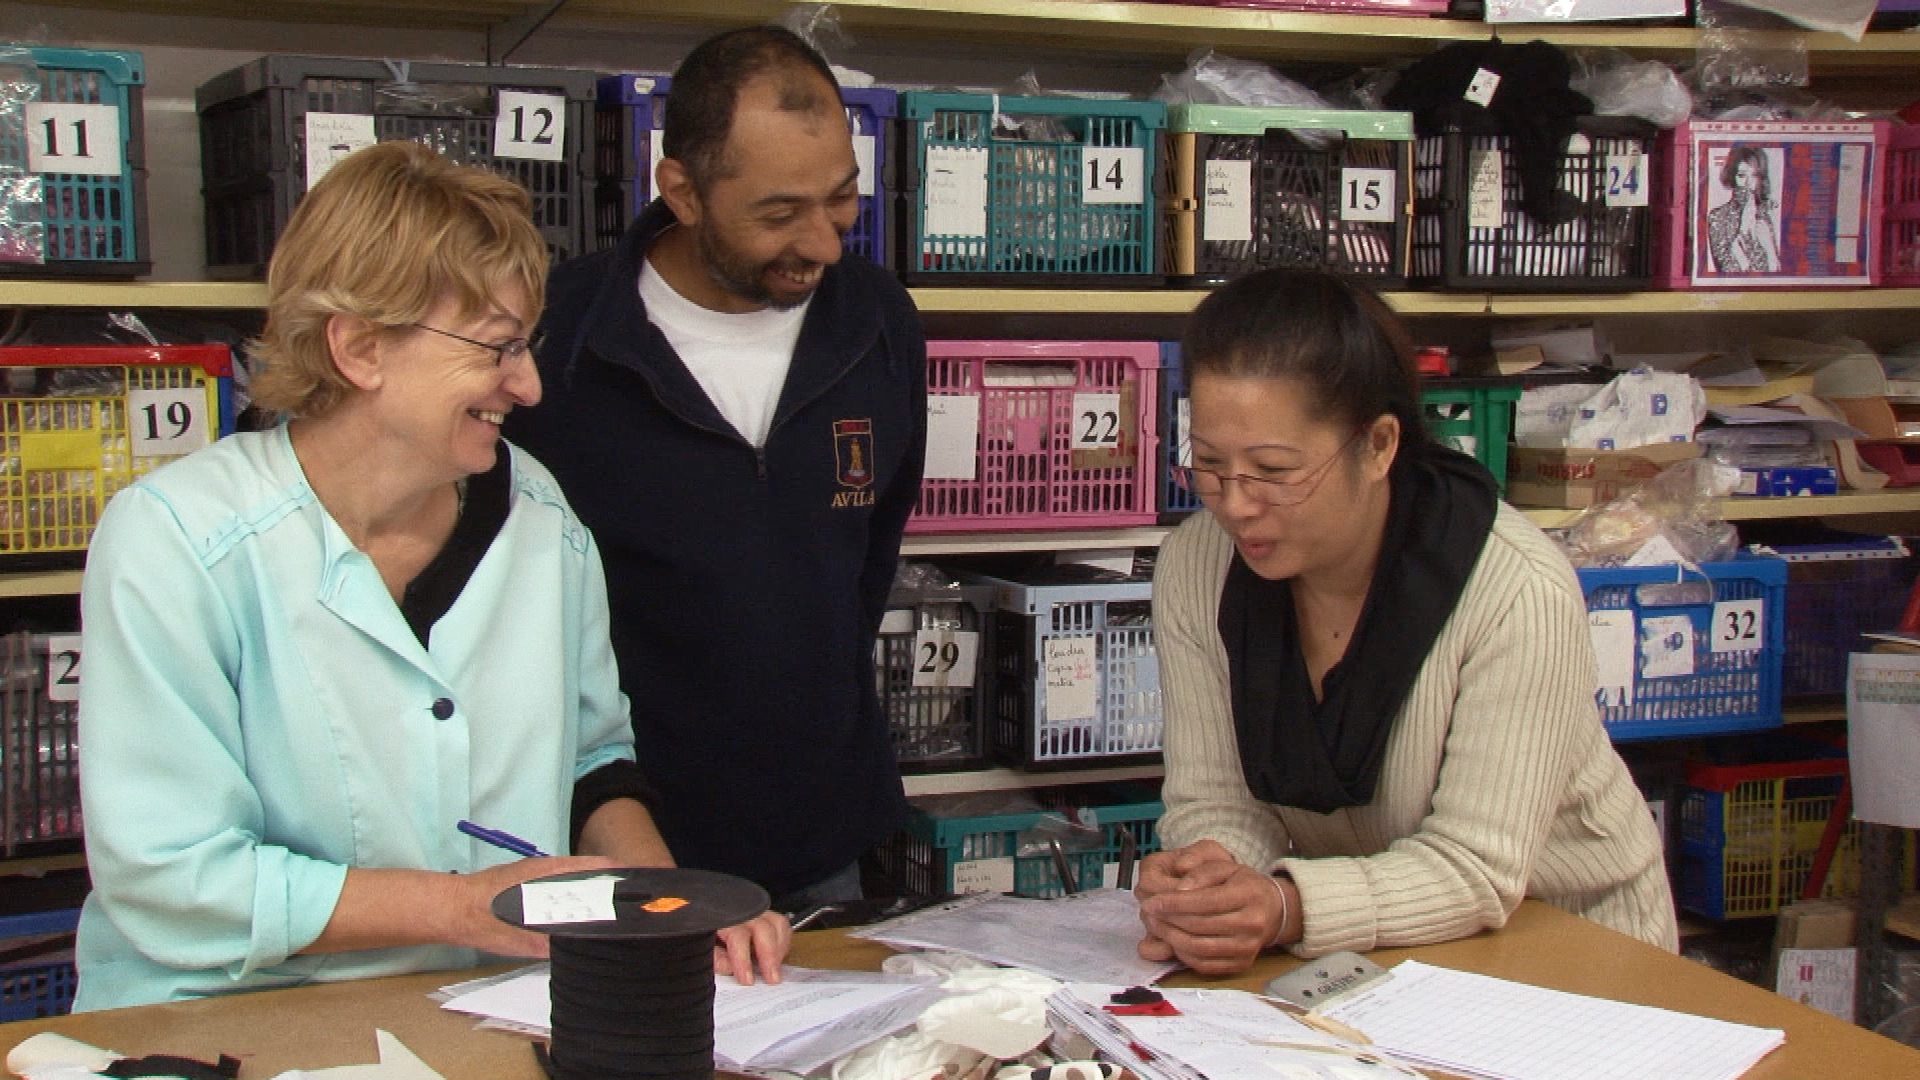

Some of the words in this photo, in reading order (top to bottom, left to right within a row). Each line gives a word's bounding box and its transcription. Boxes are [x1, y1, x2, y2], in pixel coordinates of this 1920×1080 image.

[41, 117, 94, 158] 11
[511, 105, 553, 145] 12
[1087, 157, 1124, 191] 14
[1608, 165, 1639, 195] 24
[1348, 179, 1381, 211] 15
[141, 402, 192, 440] 19
[1081, 411, 1118, 443] 22
[831, 489, 875, 507] AVILA
[1724, 610, 1756, 641] 32
[919, 641, 960, 674] 29
